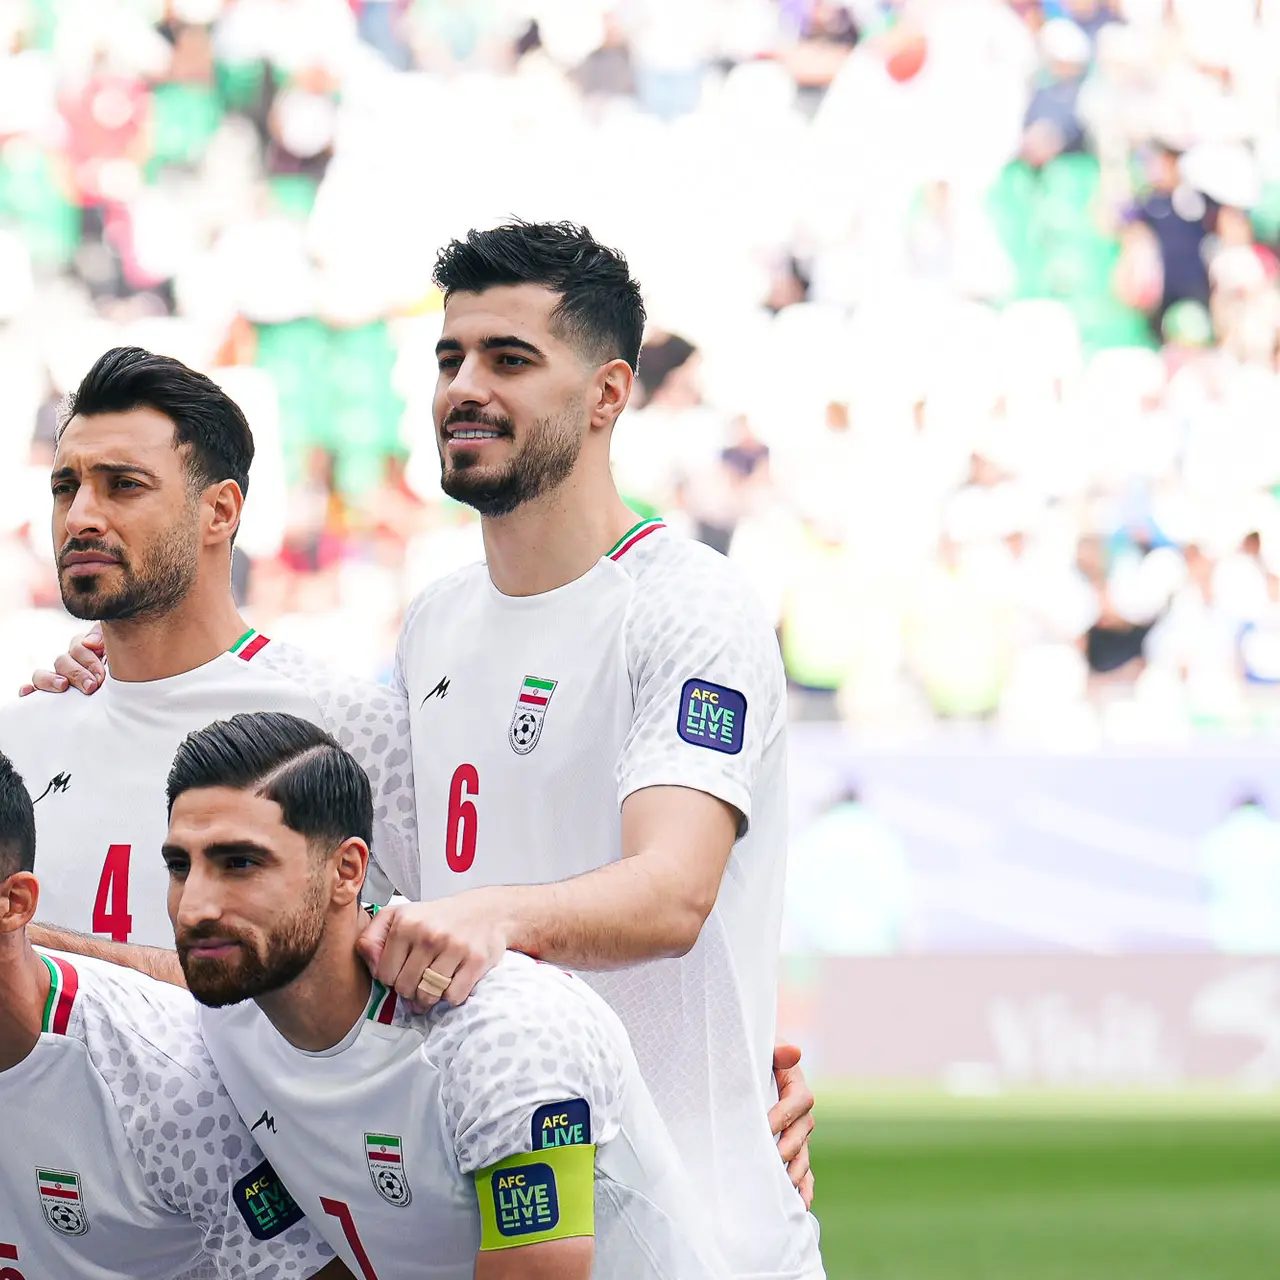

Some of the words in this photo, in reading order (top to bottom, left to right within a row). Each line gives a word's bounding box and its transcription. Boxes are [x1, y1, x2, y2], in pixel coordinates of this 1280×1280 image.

[691, 688, 719, 704] AFC
[689, 699, 735, 728] LIVE
[445, 763, 479, 873] 6
[92, 844, 132, 944] 4
[542, 1113, 569, 1129] AFC
[542, 1123, 584, 1148] LIVE
[244, 1175, 270, 1200] AFC
[498, 1174, 527, 1190] AFC
[499, 1183, 550, 1210] LIVE
